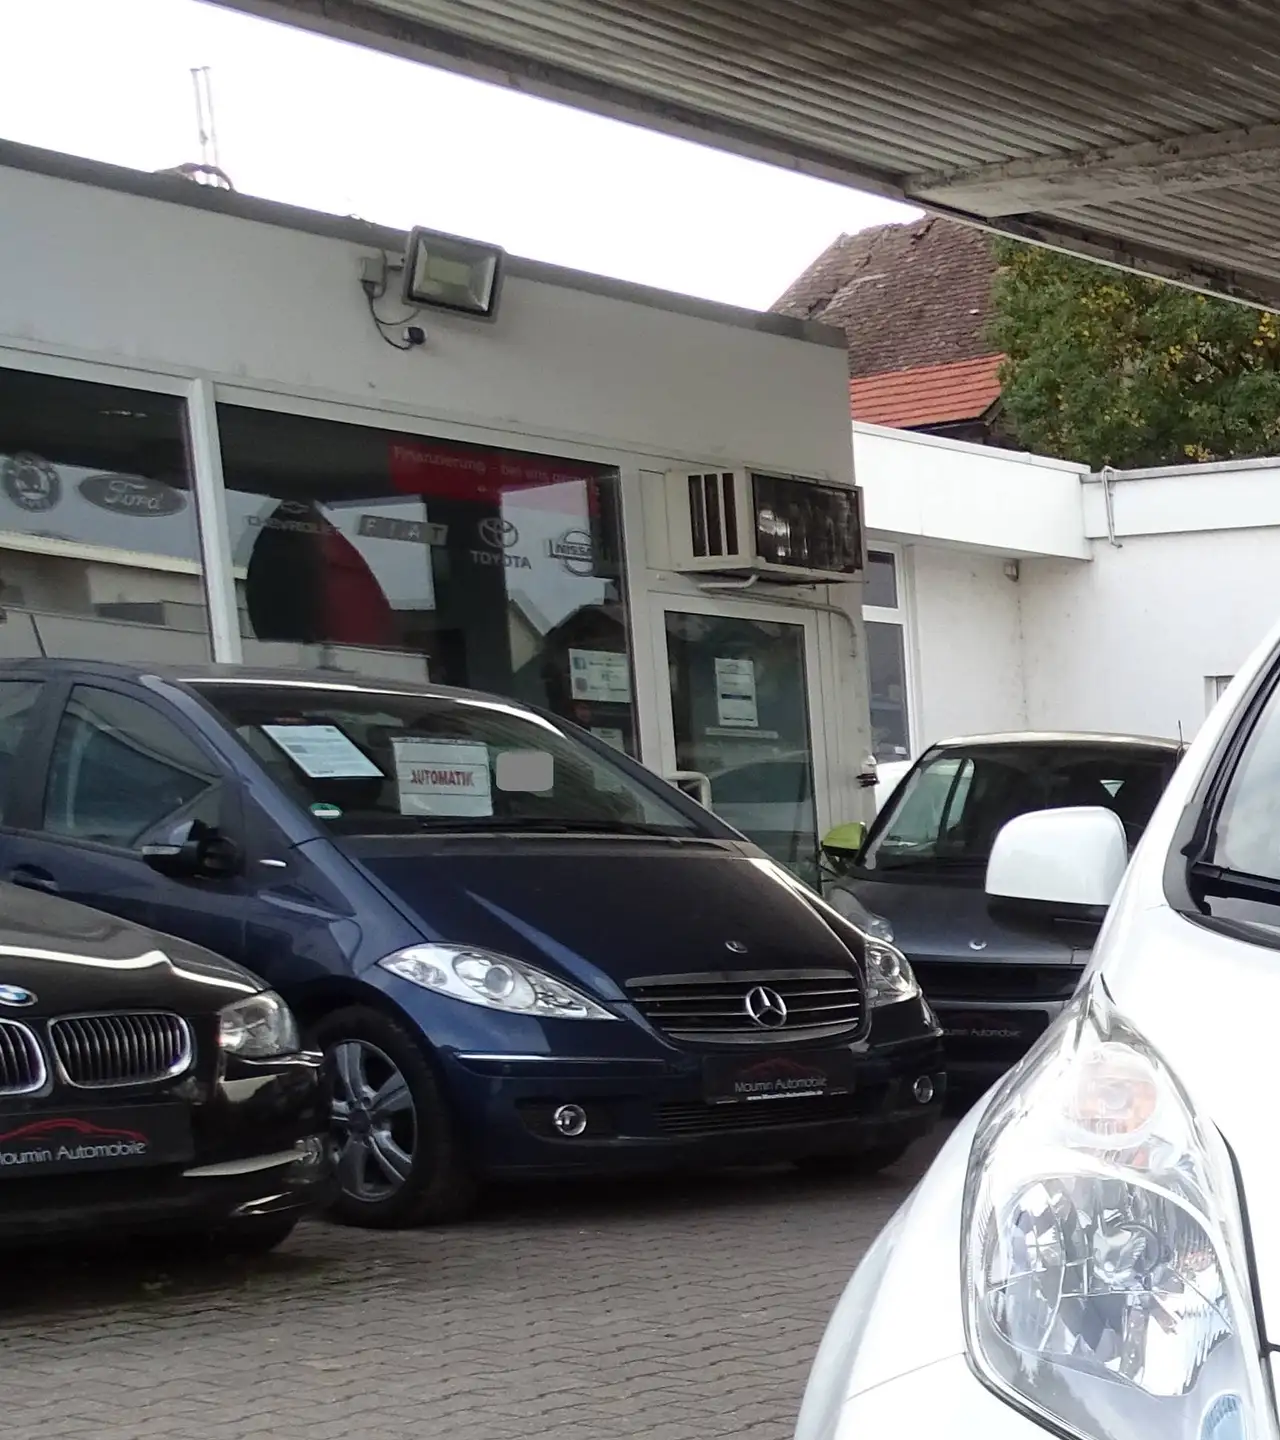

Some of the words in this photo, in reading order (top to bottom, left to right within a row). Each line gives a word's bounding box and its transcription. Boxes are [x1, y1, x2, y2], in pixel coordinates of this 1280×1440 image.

[104, 480, 164, 510] Ford
[367, 517, 445, 541] FIAT
[470, 550, 532, 570] TOYOTA
[410, 769, 475, 787] AUTOMATIK
[775, 1076, 827, 1091] Automobile
[0, 1148, 52, 1167] oumin
[56, 1140, 147, 1161] Automobile
